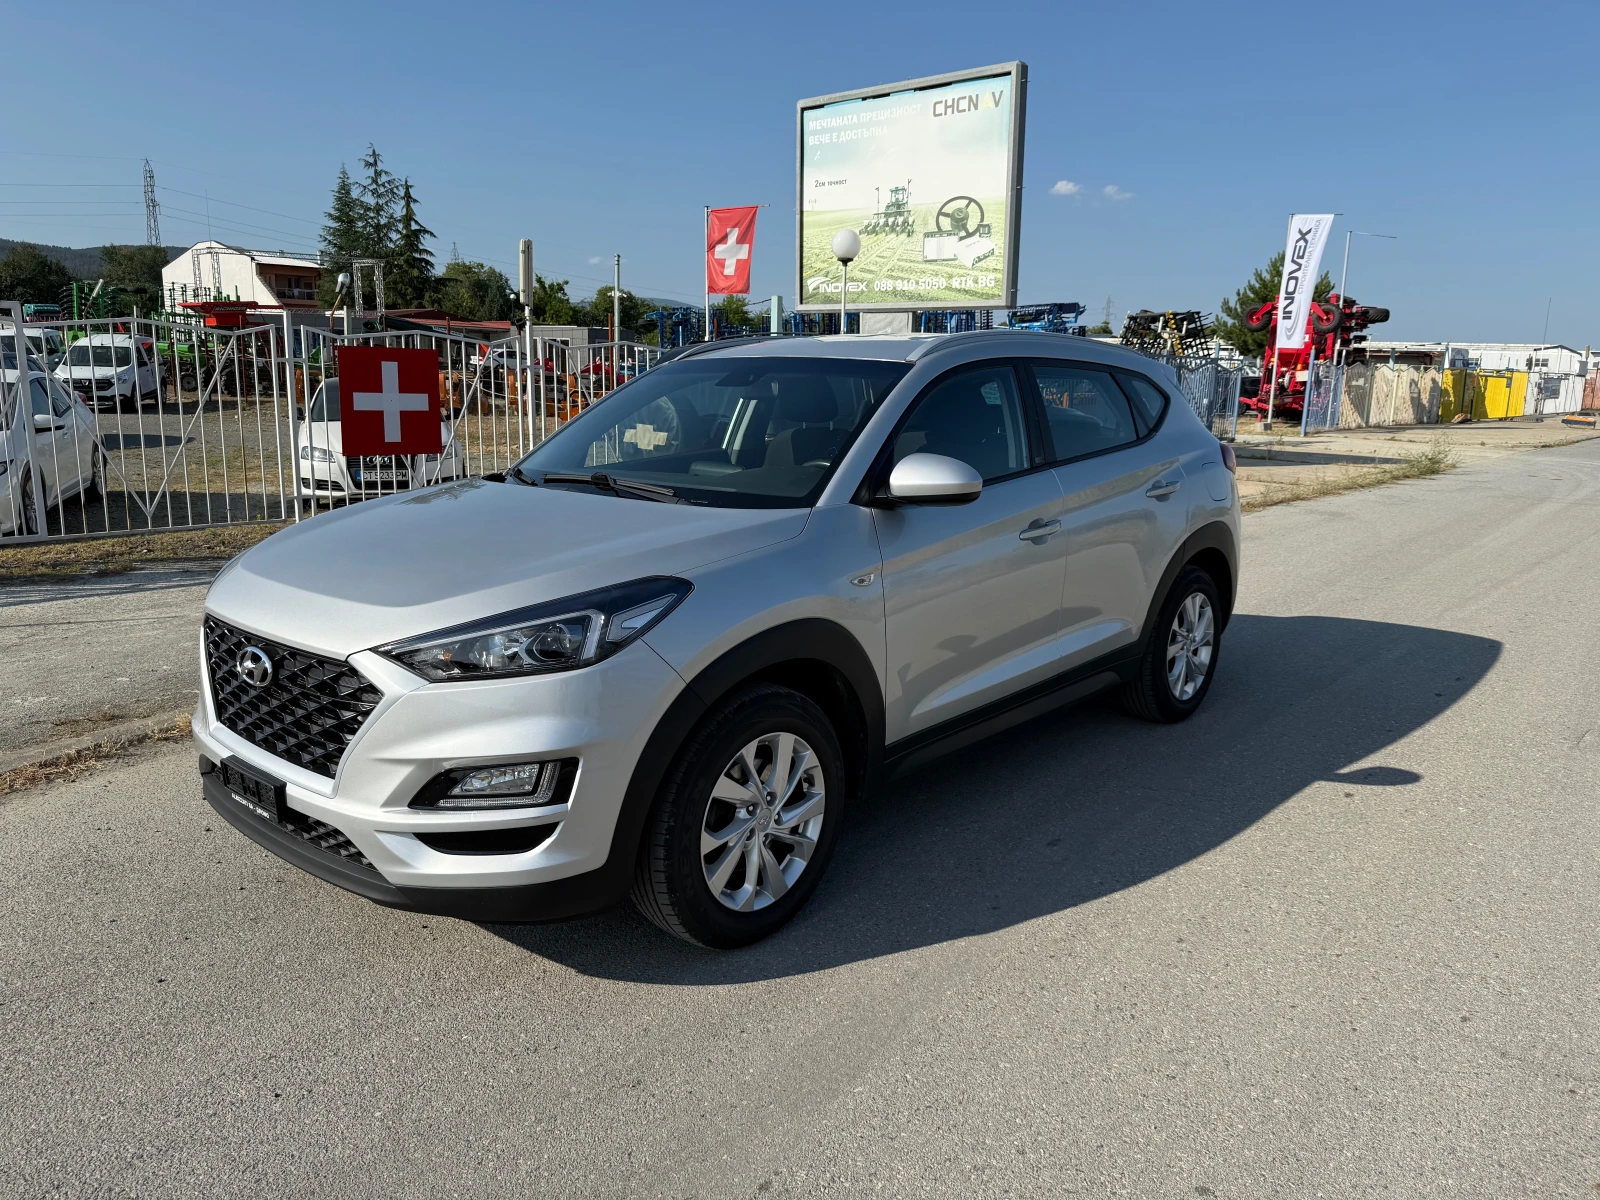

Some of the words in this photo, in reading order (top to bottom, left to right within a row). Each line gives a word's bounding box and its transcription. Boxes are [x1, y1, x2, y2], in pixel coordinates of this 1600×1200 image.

[809, 114, 858, 131] МЕЧТАНАТА
[860, 104, 922, 123] ПРЕЦИЗНОСТ
[809, 133, 831, 146] ВЕЧЕ
[832, 132, 839, 143] Е
[839, 125, 888, 143] ДОСТЪПНА
[873, 280, 893, 292] 088
[895, 280, 916, 291] 910
[918, 278, 946, 290] 5050
[951, 275, 996, 289] RTK.BG
[1282, 227, 1313, 320] INOVEX
